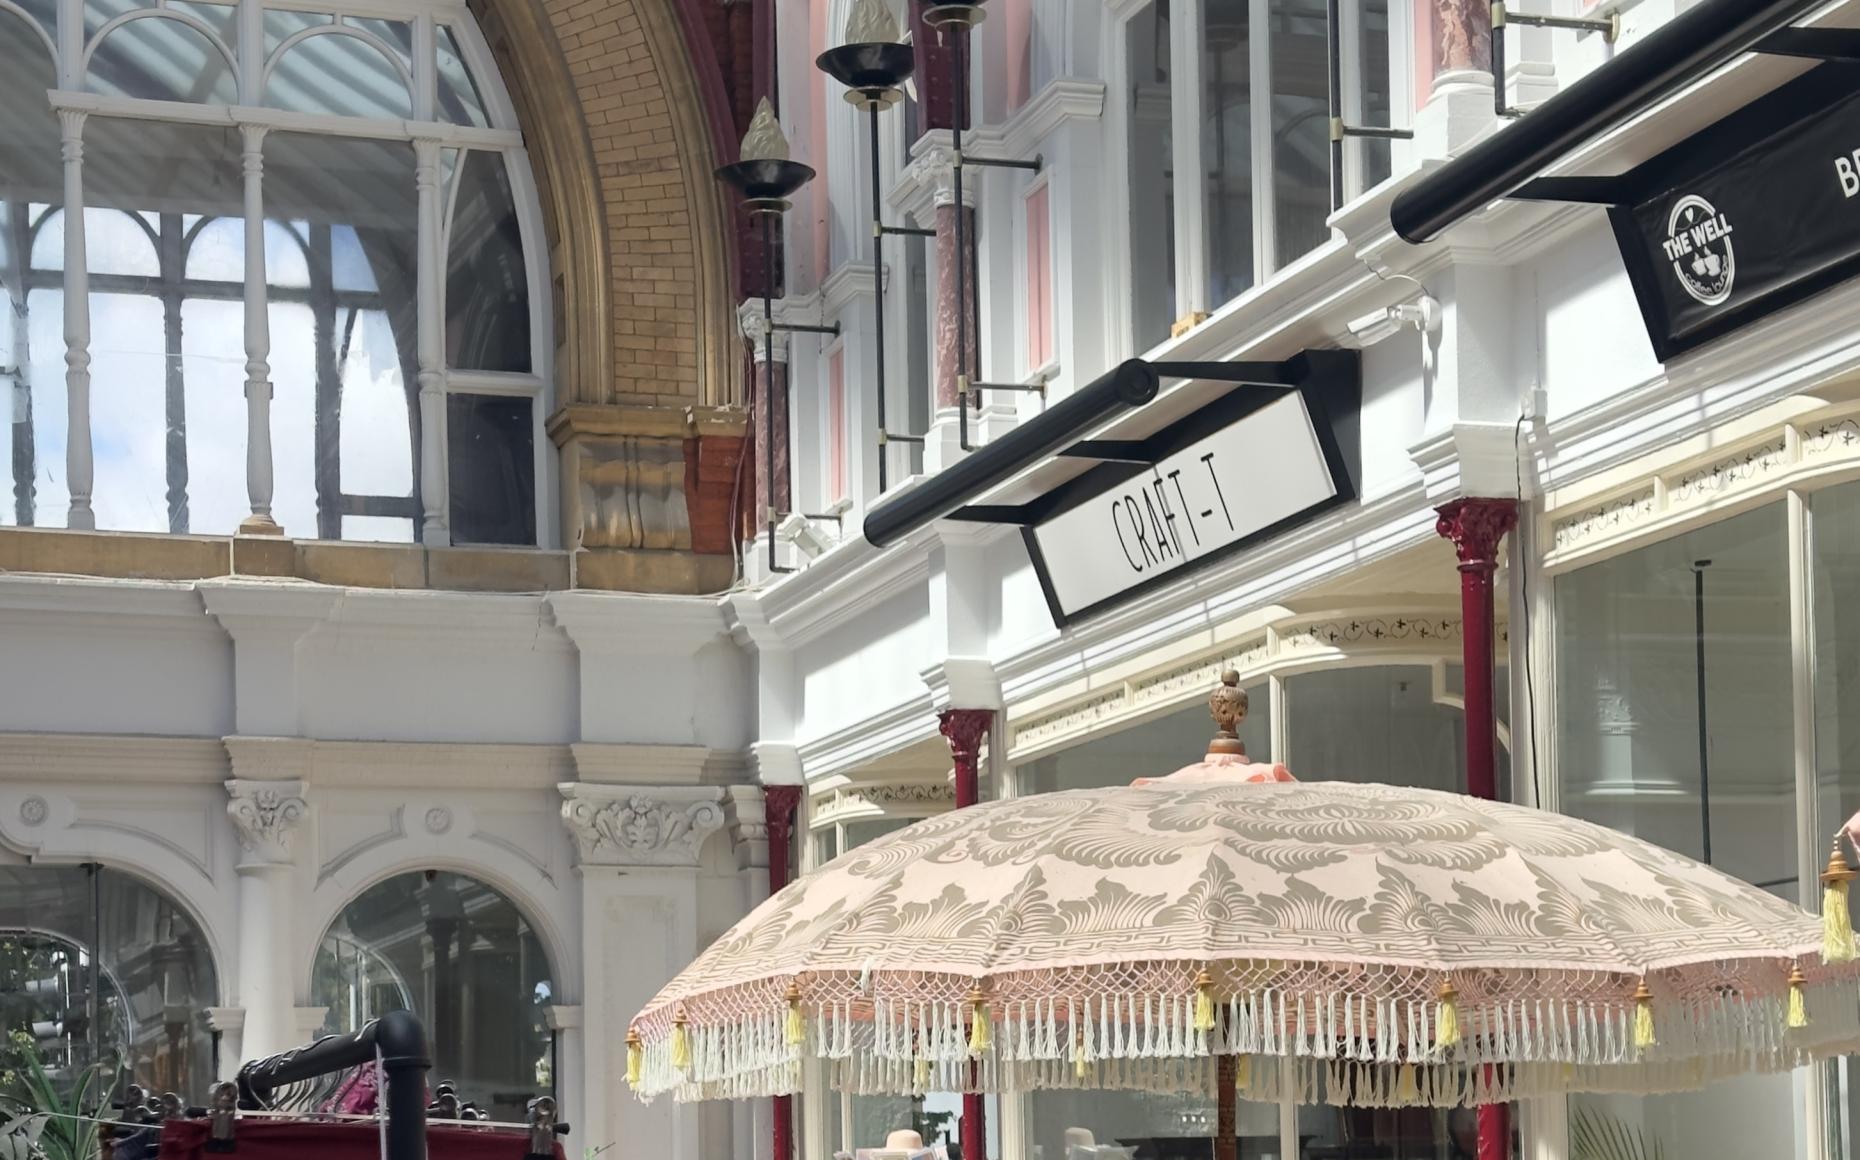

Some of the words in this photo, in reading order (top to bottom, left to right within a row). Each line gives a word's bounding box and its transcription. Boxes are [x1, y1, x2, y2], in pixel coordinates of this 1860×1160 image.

[1662, 232, 1692, 261] THE
[1690, 213, 1733, 247] WELL
[1112, 452, 1234, 572] CRAFT-T
